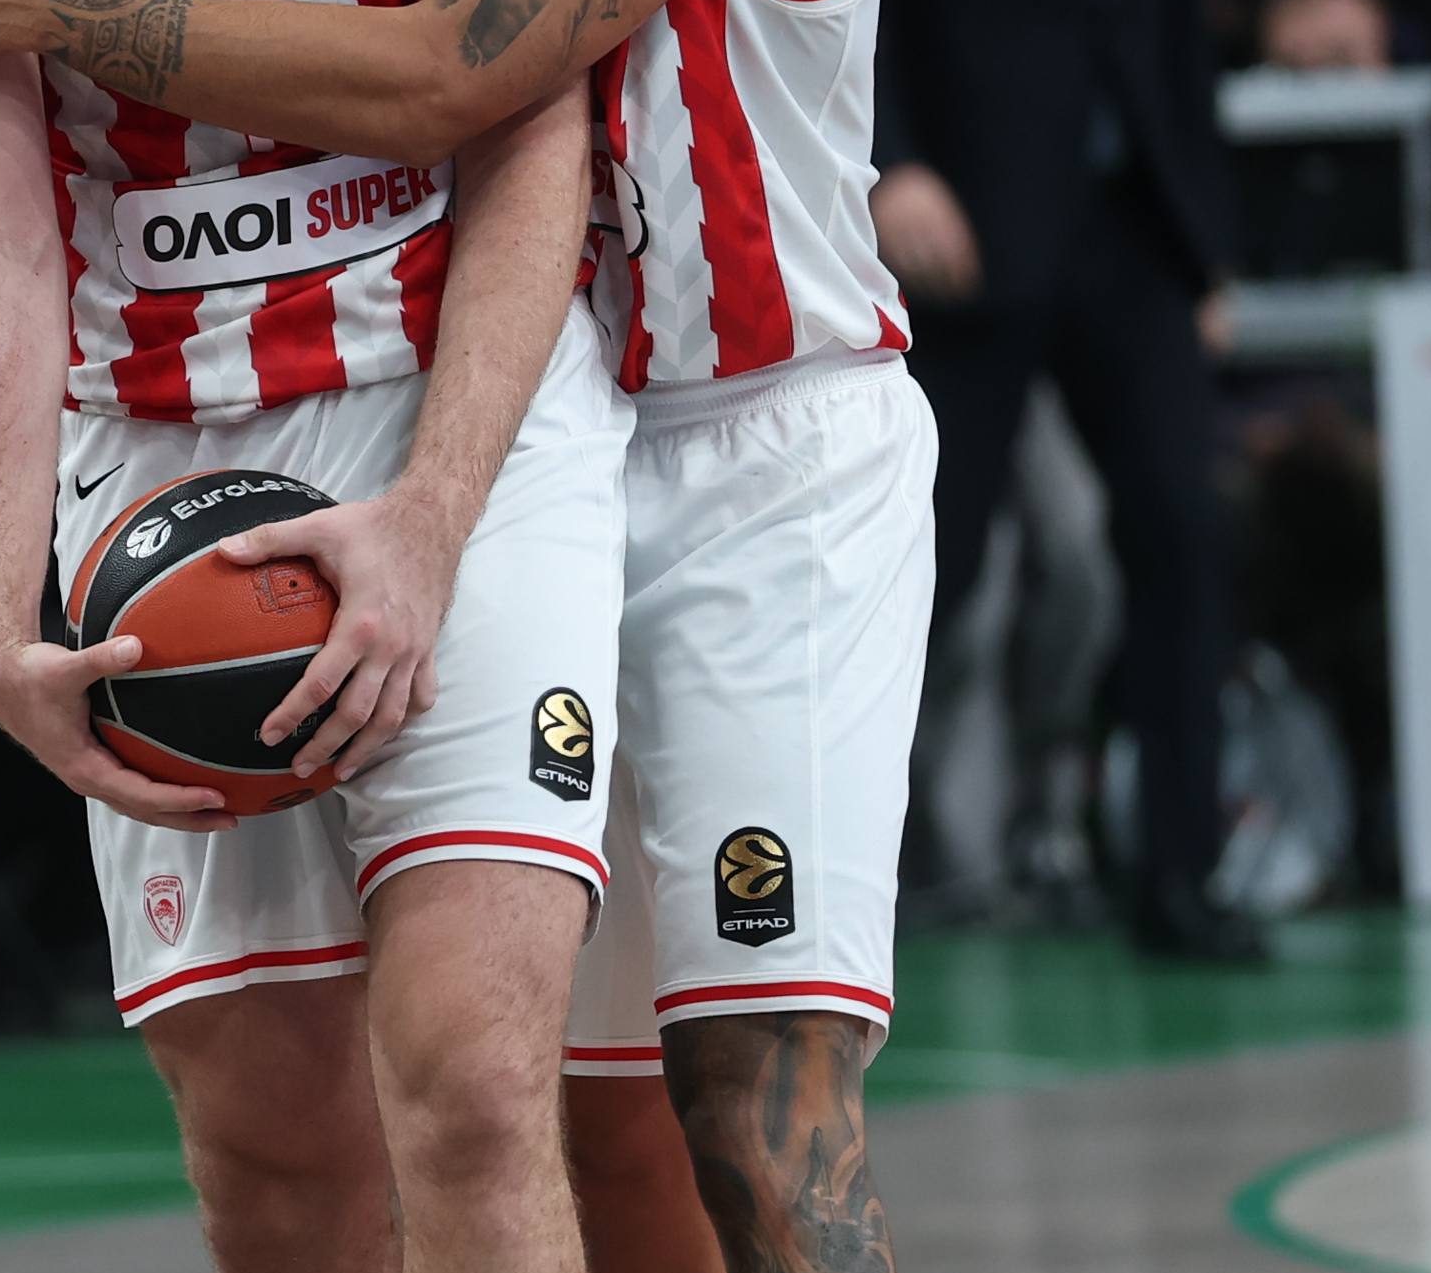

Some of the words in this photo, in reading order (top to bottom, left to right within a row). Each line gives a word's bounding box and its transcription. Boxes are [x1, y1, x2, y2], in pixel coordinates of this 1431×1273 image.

[306, 166, 437, 239] SUPER
[535, 767, 589, 793] ETIHAD
[722, 917, 789, 931] ETIHAD
